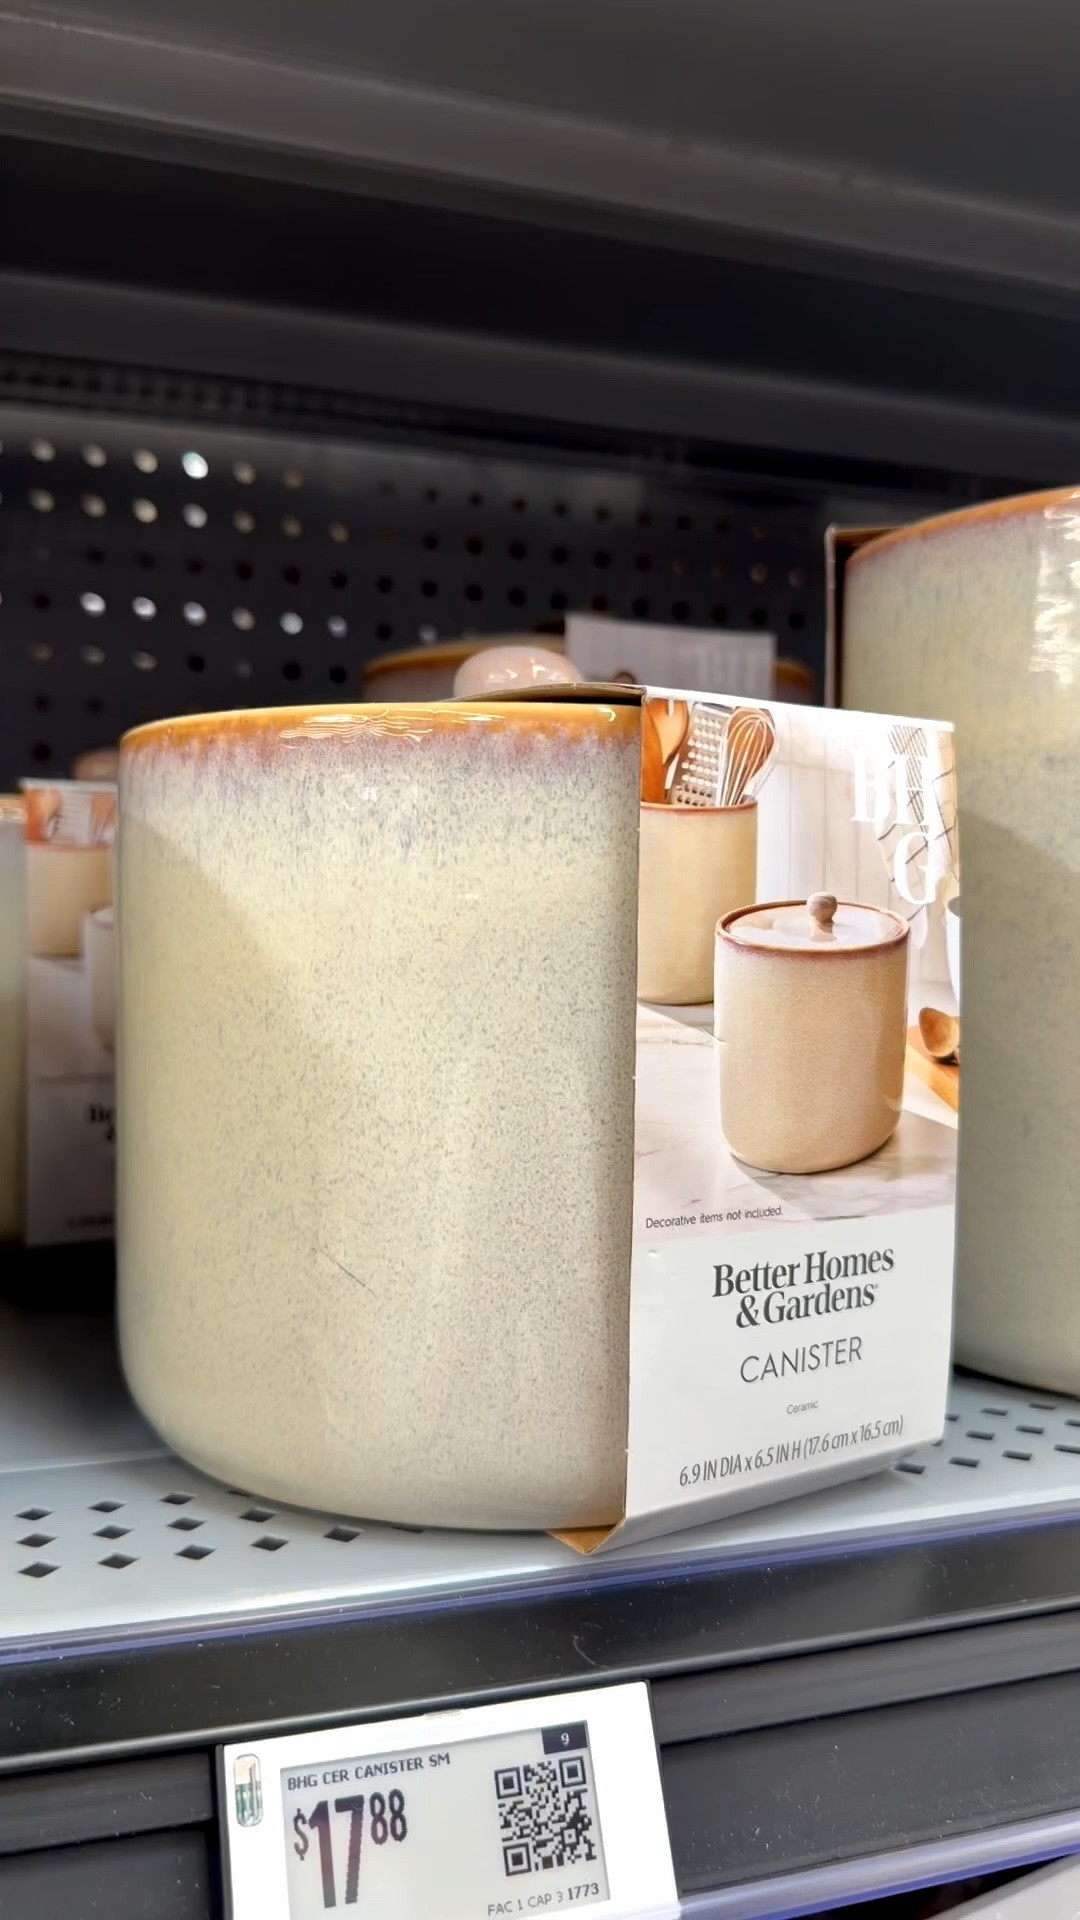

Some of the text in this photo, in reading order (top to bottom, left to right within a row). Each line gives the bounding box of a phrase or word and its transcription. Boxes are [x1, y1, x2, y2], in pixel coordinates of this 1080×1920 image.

[645, 1205, 784, 1229] Decorative items not included.
[712, 1248, 894, 1298] Better Homes
[763, 1282, 876, 1324] Gardens
[740, 1336, 863, 1383] CANISTER
[786, 1400, 818, 1415] Ceramic
[679, 1415, 904, 1486] 6.9 IN DIA x 6.5 IN H (17.6 cm x 16.5 cm)
[560, 1732, 570, 1745] 9
[287, 1752, 450, 1791] BHG CER CANISTER SM
[487, 1882, 600, 1917] FAC 1 CAP 3 1773
